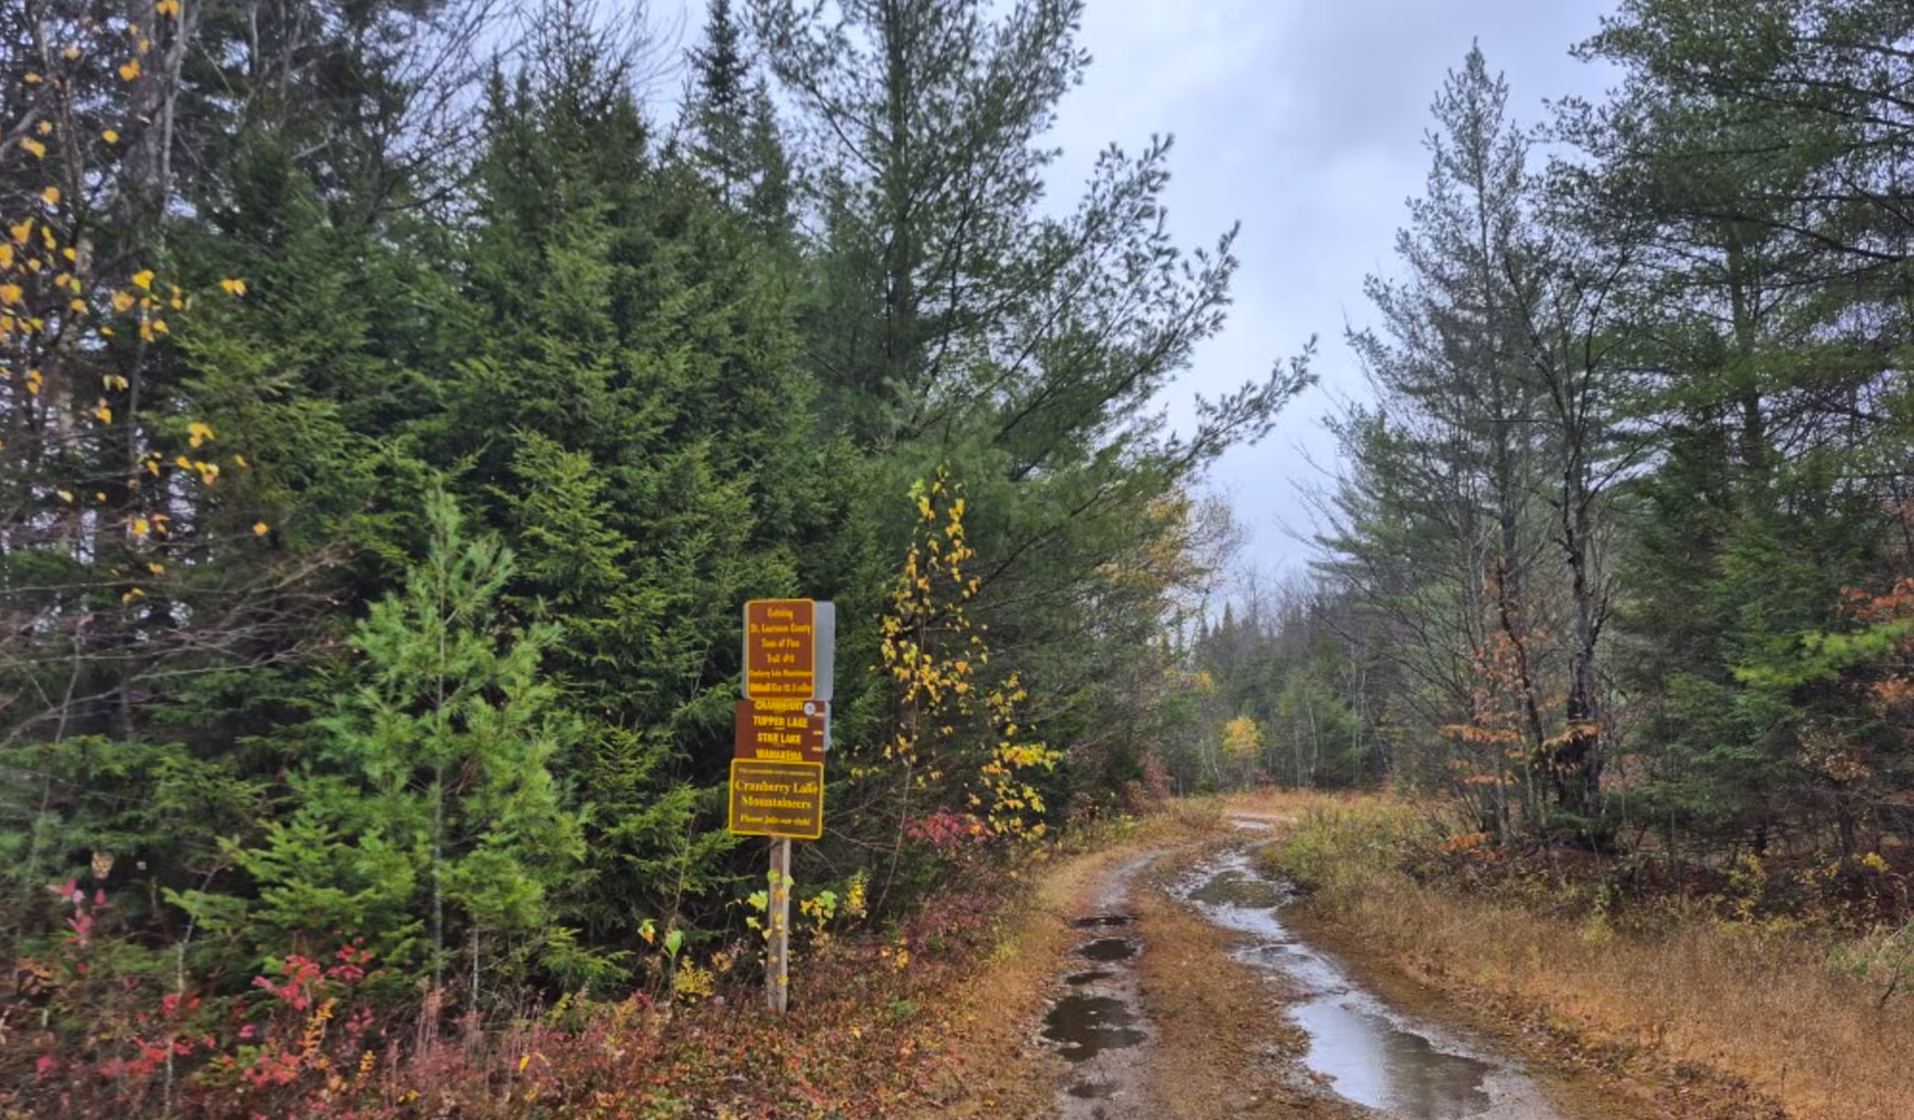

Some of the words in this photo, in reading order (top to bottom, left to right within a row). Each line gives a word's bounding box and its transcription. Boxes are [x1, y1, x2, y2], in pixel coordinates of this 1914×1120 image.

[752, 716, 785, 727] TUPPER
[787, 717, 808, 728] LAKE
[757, 733, 778, 744] STAR
[781, 733, 802, 745] LAKE
[735, 780, 791, 795] Cranberry
[793, 781, 818, 794] Lake
[740, 795, 812, 810] Mountaineers
